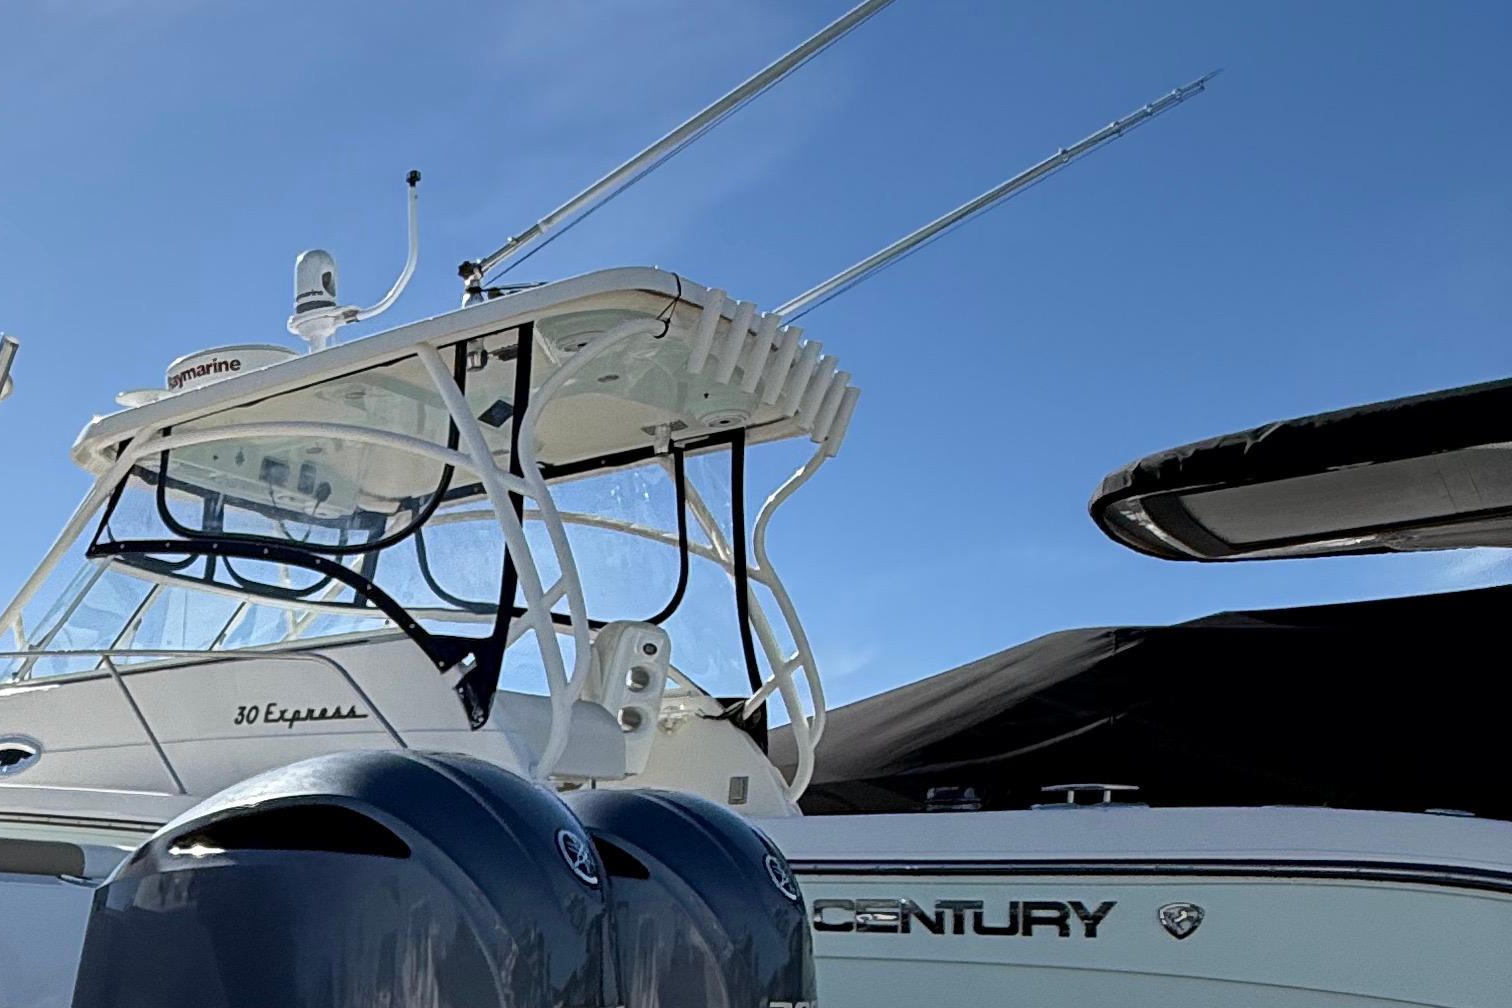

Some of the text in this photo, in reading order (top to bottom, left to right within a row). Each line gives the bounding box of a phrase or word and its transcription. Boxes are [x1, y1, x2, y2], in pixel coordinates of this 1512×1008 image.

[234, 702, 368, 729] 30 Express
[813, 899, 1118, 938] CENTURY
